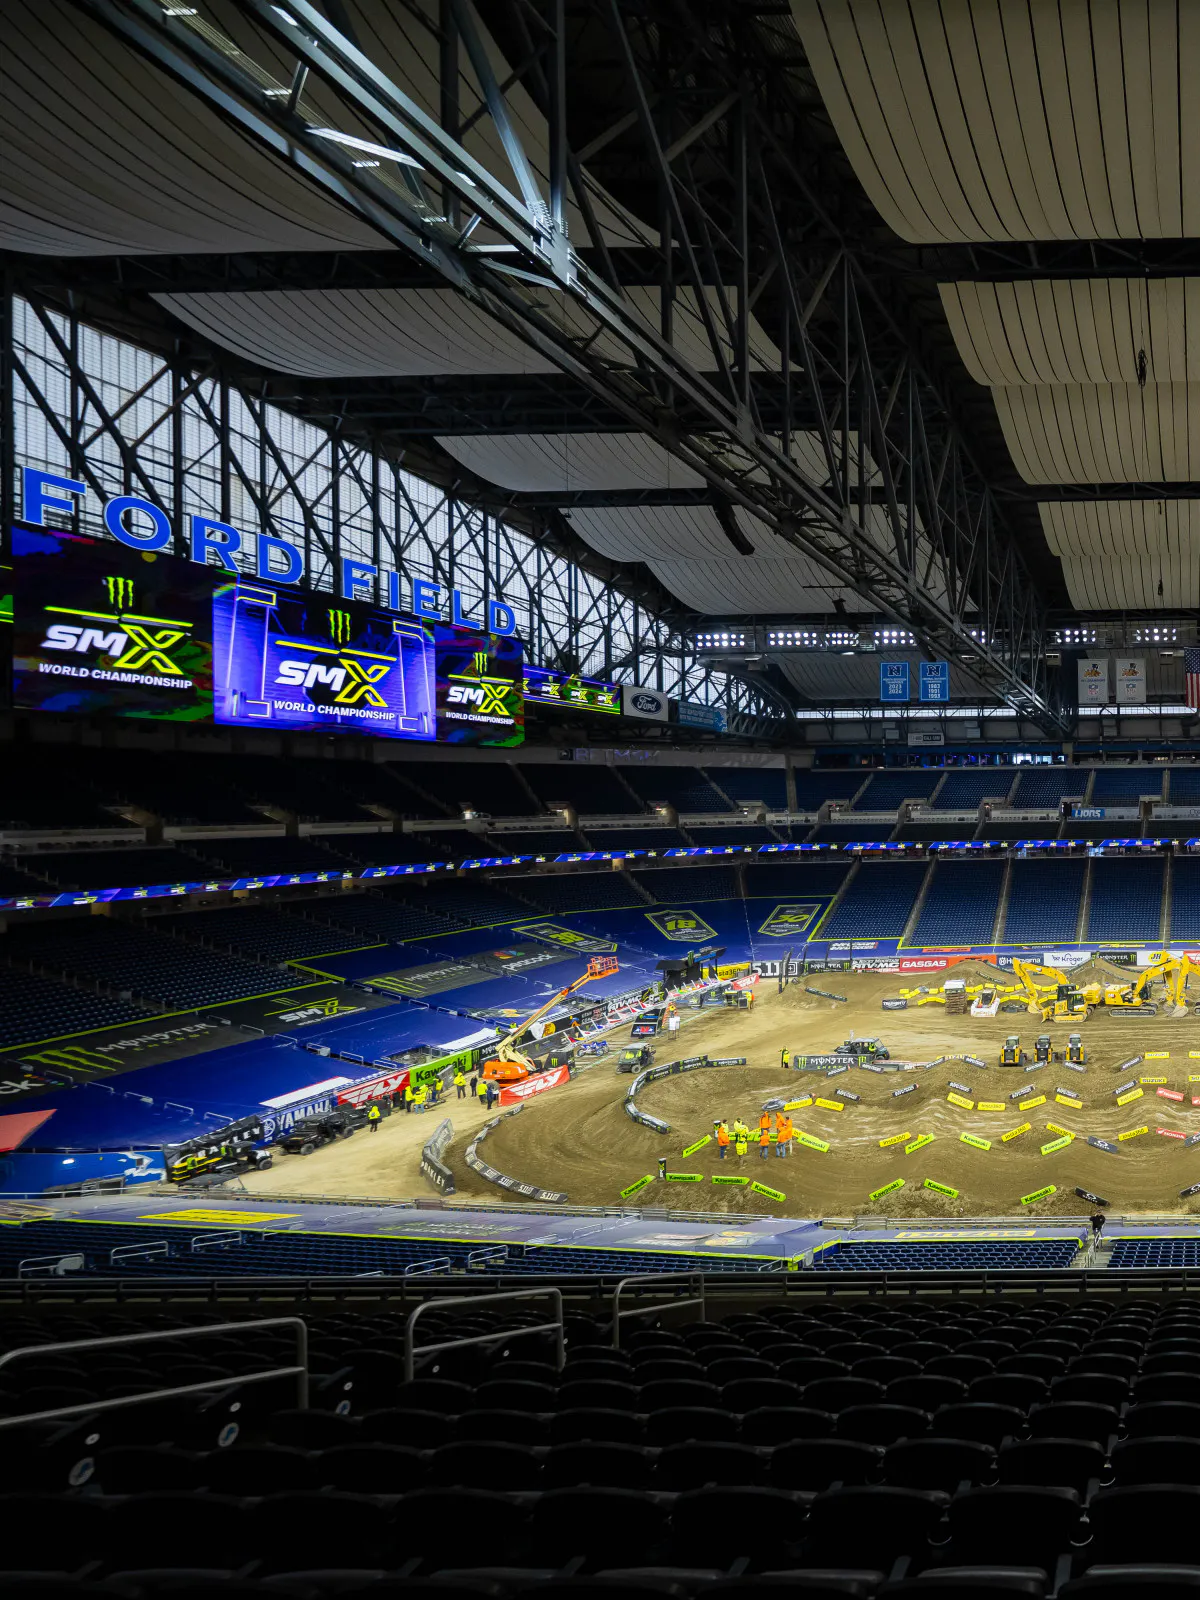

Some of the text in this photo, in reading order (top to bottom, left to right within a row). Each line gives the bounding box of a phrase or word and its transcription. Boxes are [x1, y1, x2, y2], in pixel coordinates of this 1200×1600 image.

[21, 467, 518, 636] FORD FIELD
[41, 624, 186, 676] SMX
[38, 663, 193, 689] WORLD CHAMPIONSHIP
[275, 658, 391, 707] SMX
[447, 683, 511, 716] SMX
[637, 696, 657, 712] Ford
[274, 700, 395, 721] WORLD CHAMPIONSHIP
[446, 711, 514, 726] WORLD CHAMPIONSHIP
[665, 919, 697, 931] 18
[502, 954, 556, 971] peacock
[901, 960, 947, 968] GASGAS
[1061, 953, 1084, 965] Kroger
[356, 1074, 408, 1101] FLY
[515, 1070, 562, 1096] FLY
[276, 1100, 332, 1131] YAMAHA
[883, 1134, 906, 1145] Insta360
[624, 1178, 648, 1197] Kawasaki
[754, 1184, 781, 1200] Kawasaki
[873, 1182, 900, 1199] Kawasaki
[927, 1181, 955, 1196] Kawasaki
[1024, 1188, 1052, 1203] Kawasaki
